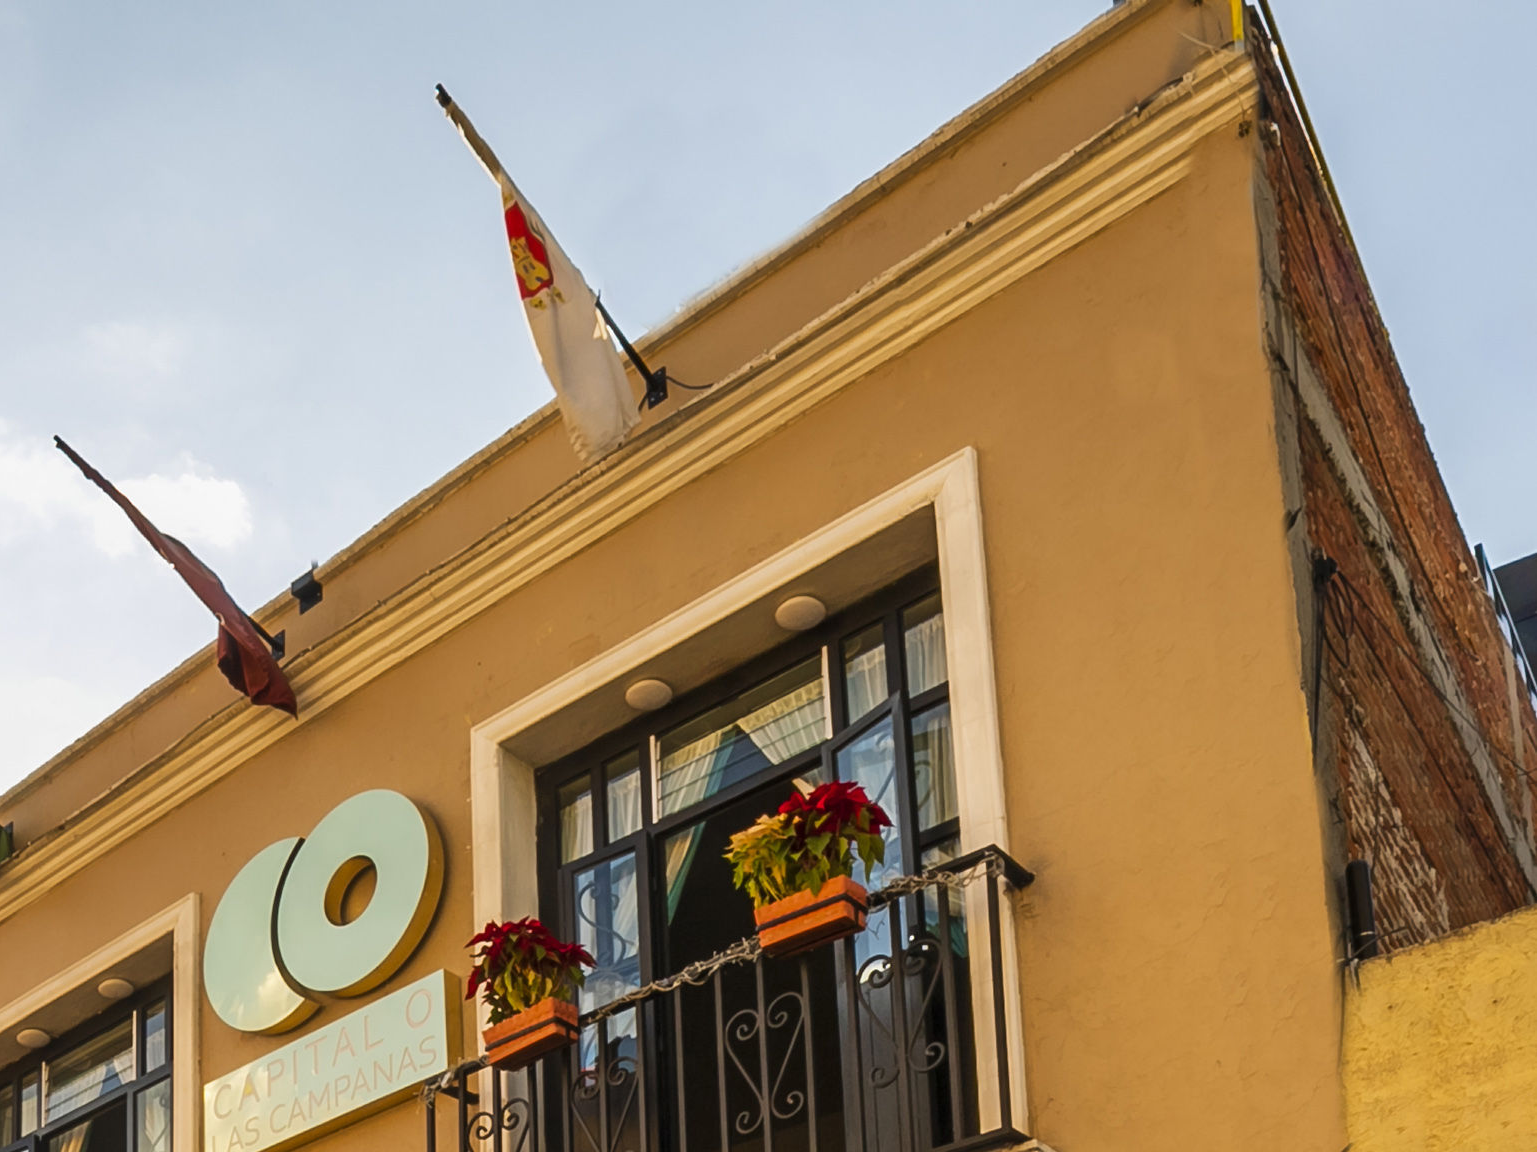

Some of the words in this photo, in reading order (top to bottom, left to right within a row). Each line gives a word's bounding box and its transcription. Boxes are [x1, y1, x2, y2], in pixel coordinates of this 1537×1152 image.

[213, 1014, 384, 1120] CAPITAL
[405, 988, 433, 1030] O
[269, 1034, 438, 1134] CAMPANAS
